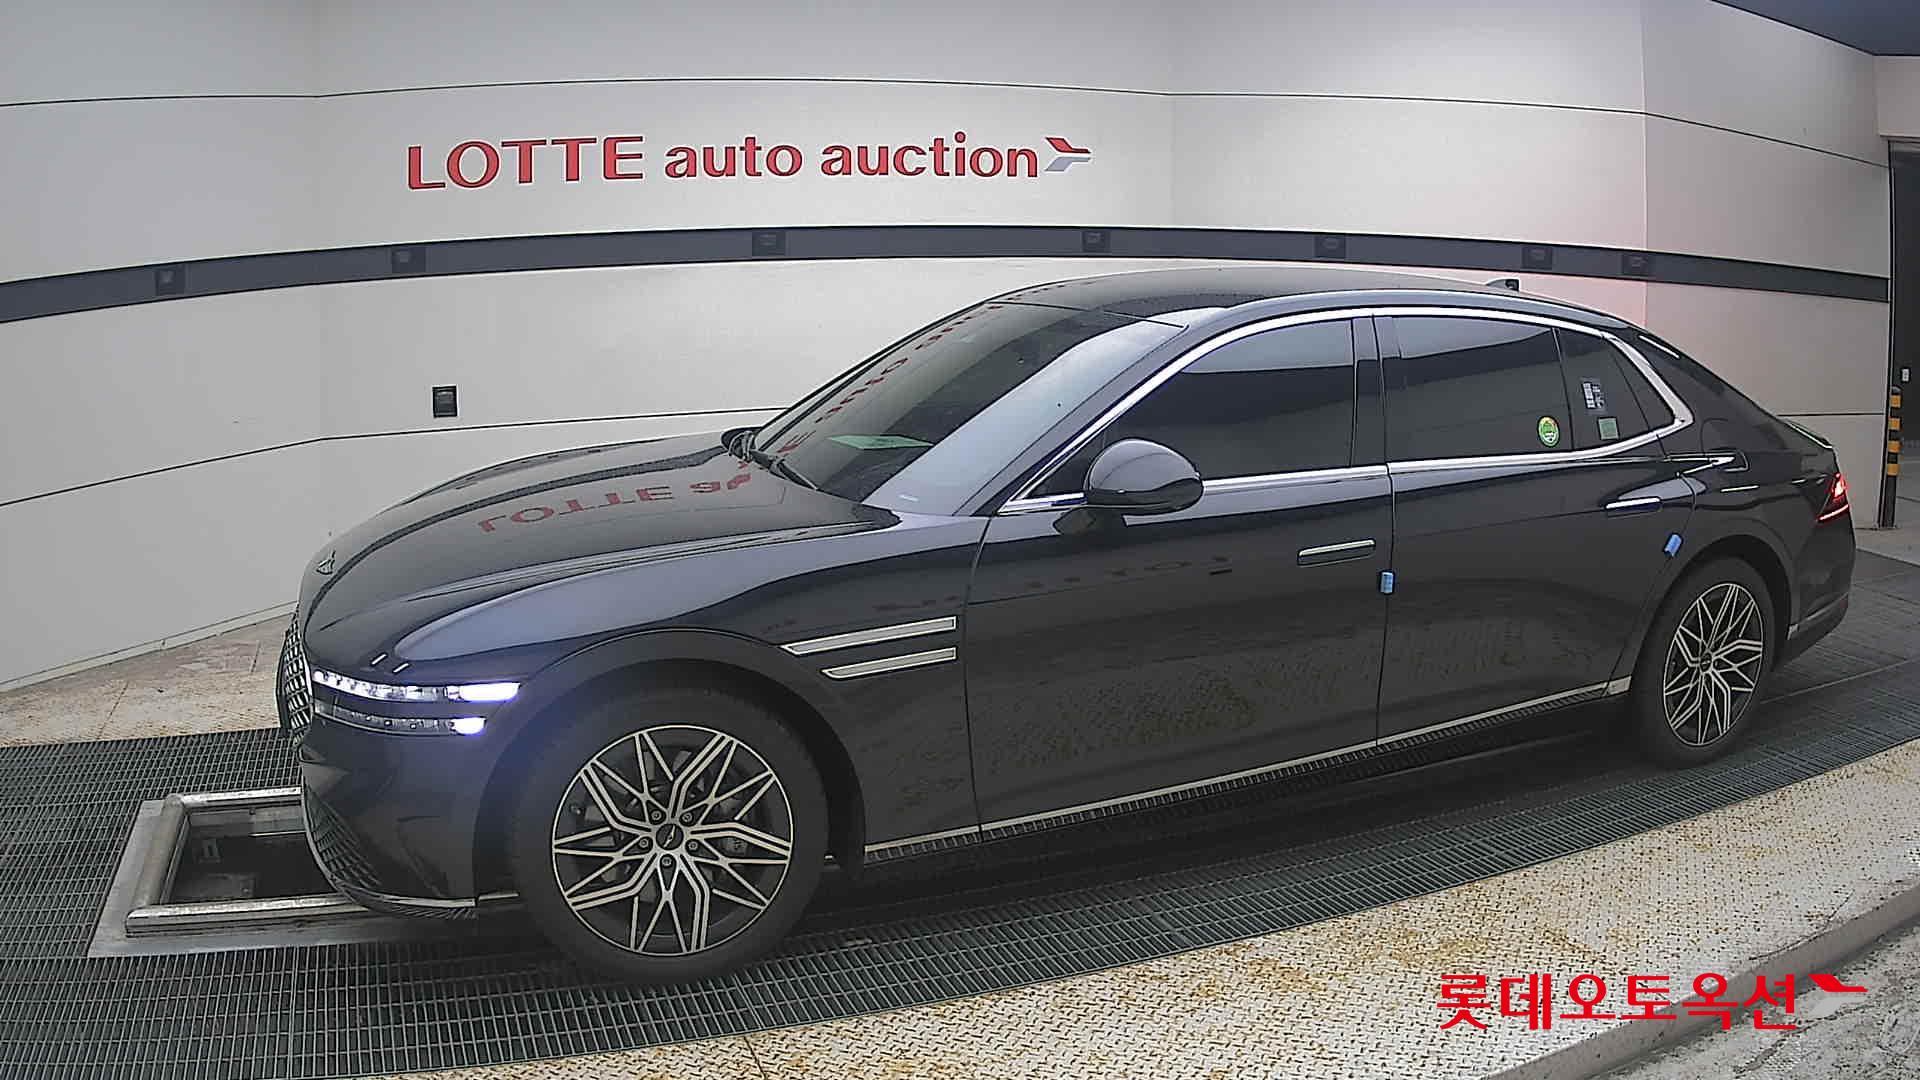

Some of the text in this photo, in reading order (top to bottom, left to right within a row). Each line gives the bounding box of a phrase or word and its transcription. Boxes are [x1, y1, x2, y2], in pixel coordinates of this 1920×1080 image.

[407, 131, 1039, 190] LOTTE auto auction
